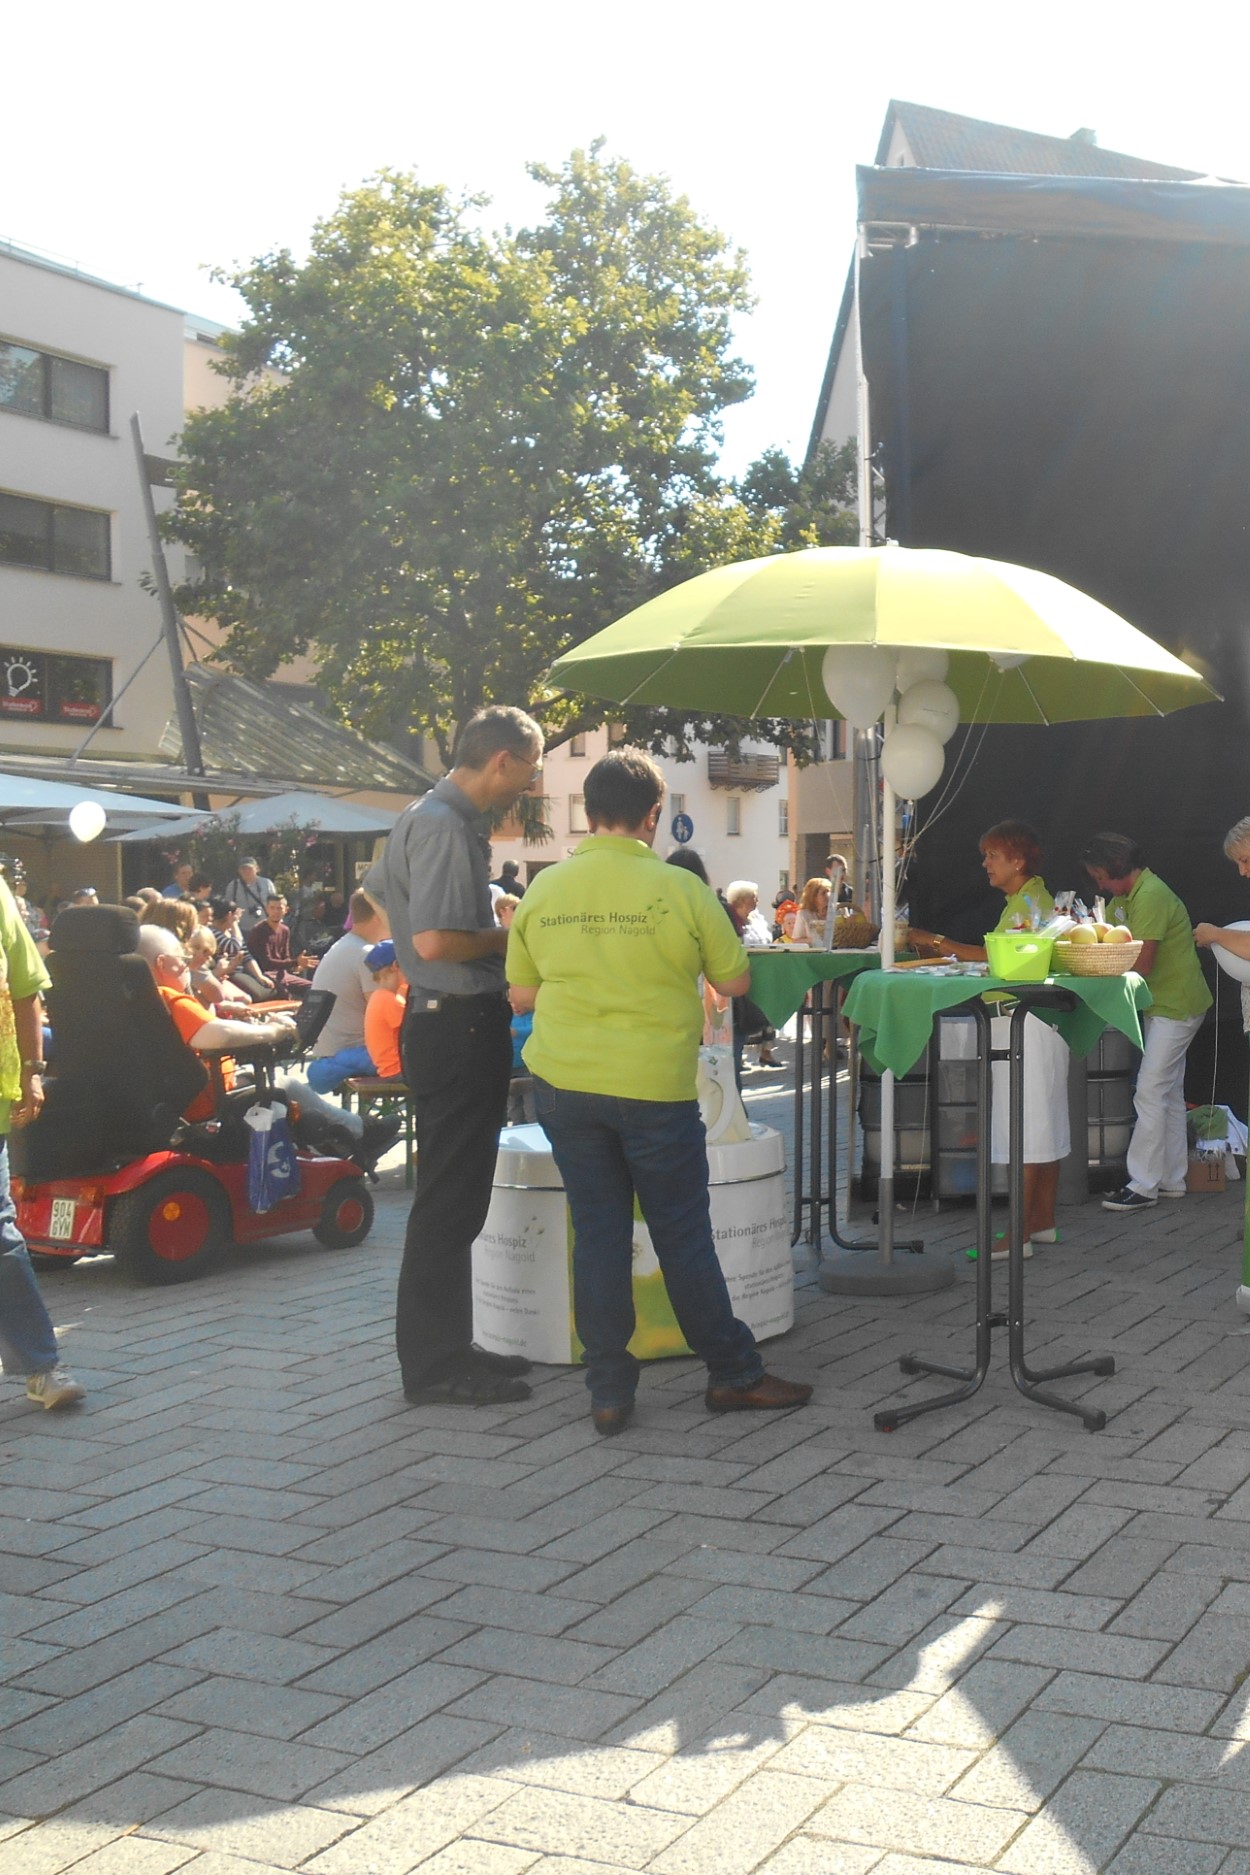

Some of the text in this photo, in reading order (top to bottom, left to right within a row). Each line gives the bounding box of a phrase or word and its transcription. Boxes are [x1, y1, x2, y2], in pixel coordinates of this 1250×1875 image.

[540, 912, 648, 928] Stationäres Hospiz
[581, 924, 656, 937] Region Nagold
[53, 1201, 71, 1218] 904
[498, 1233, 527, 1250] Hospiz
